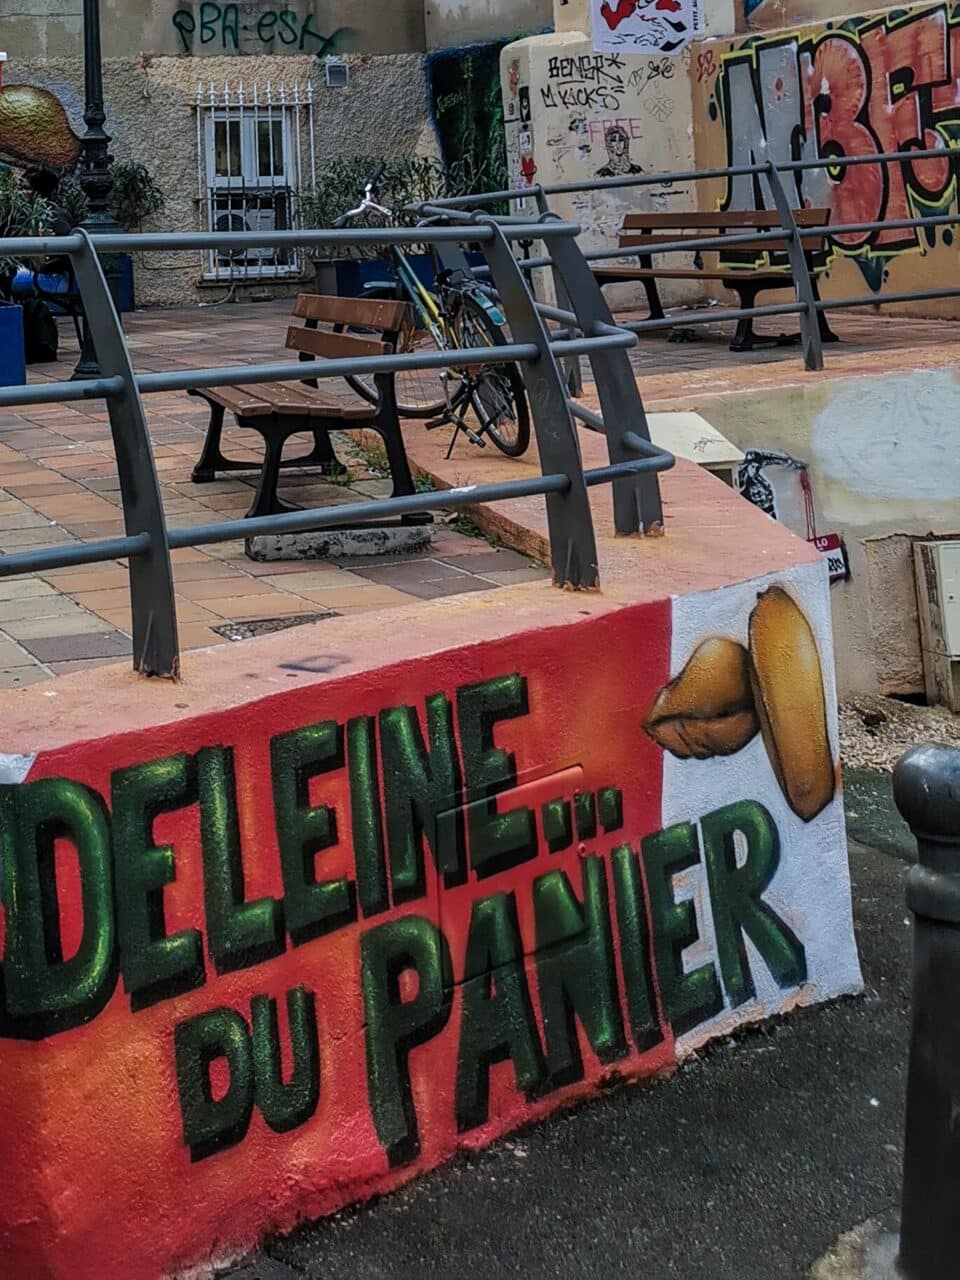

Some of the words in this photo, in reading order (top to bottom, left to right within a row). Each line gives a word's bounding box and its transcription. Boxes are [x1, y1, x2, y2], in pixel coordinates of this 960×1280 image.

[588, 117, 644, 143] FREE
[174, 986, 320, 1162] DU
[360, 799, 808, 1168] PANIER
